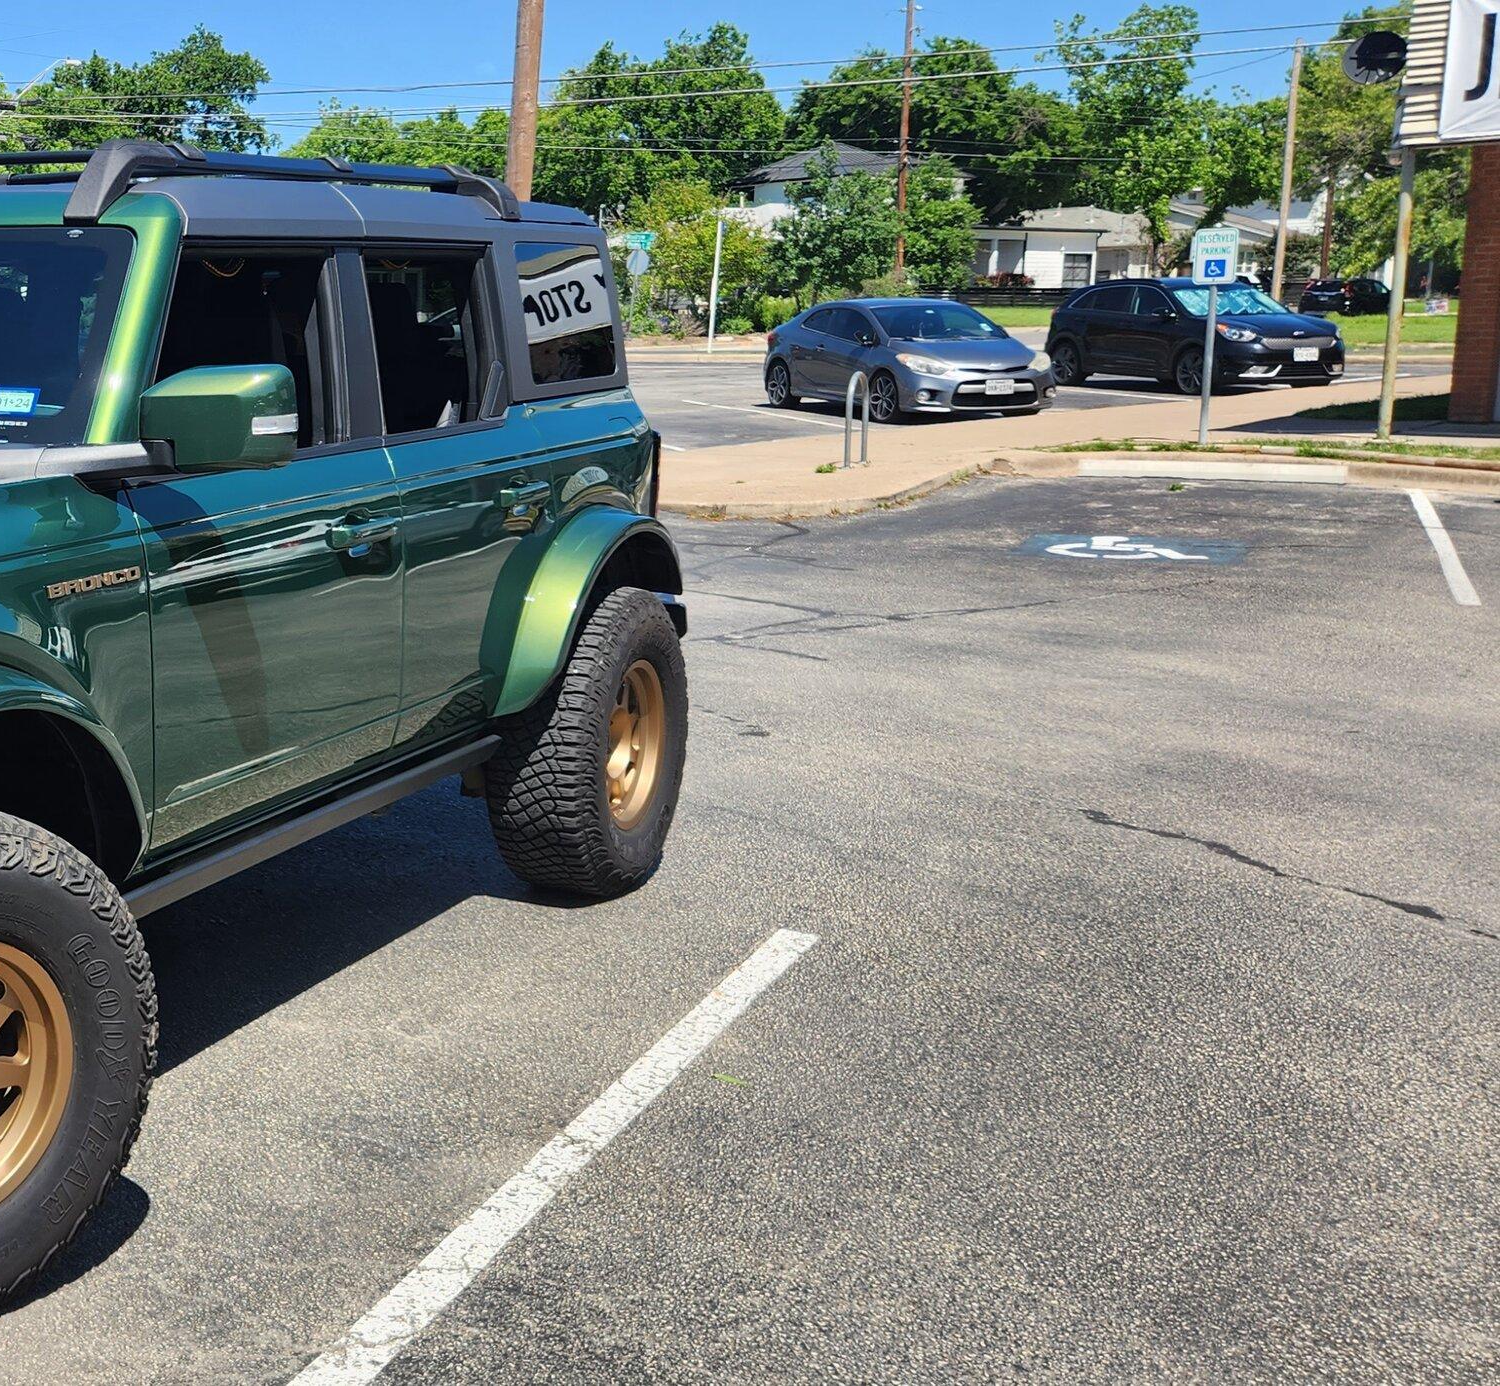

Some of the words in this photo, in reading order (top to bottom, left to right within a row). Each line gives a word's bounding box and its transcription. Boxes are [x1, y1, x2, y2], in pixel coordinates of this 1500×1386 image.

[1463, 13, 1500, 101] J
[1199, 234, 1235, 243] RESERVED
[1201, 246, 1231, 255] PARKING
[47, 565, 141, 599] BRONCO
